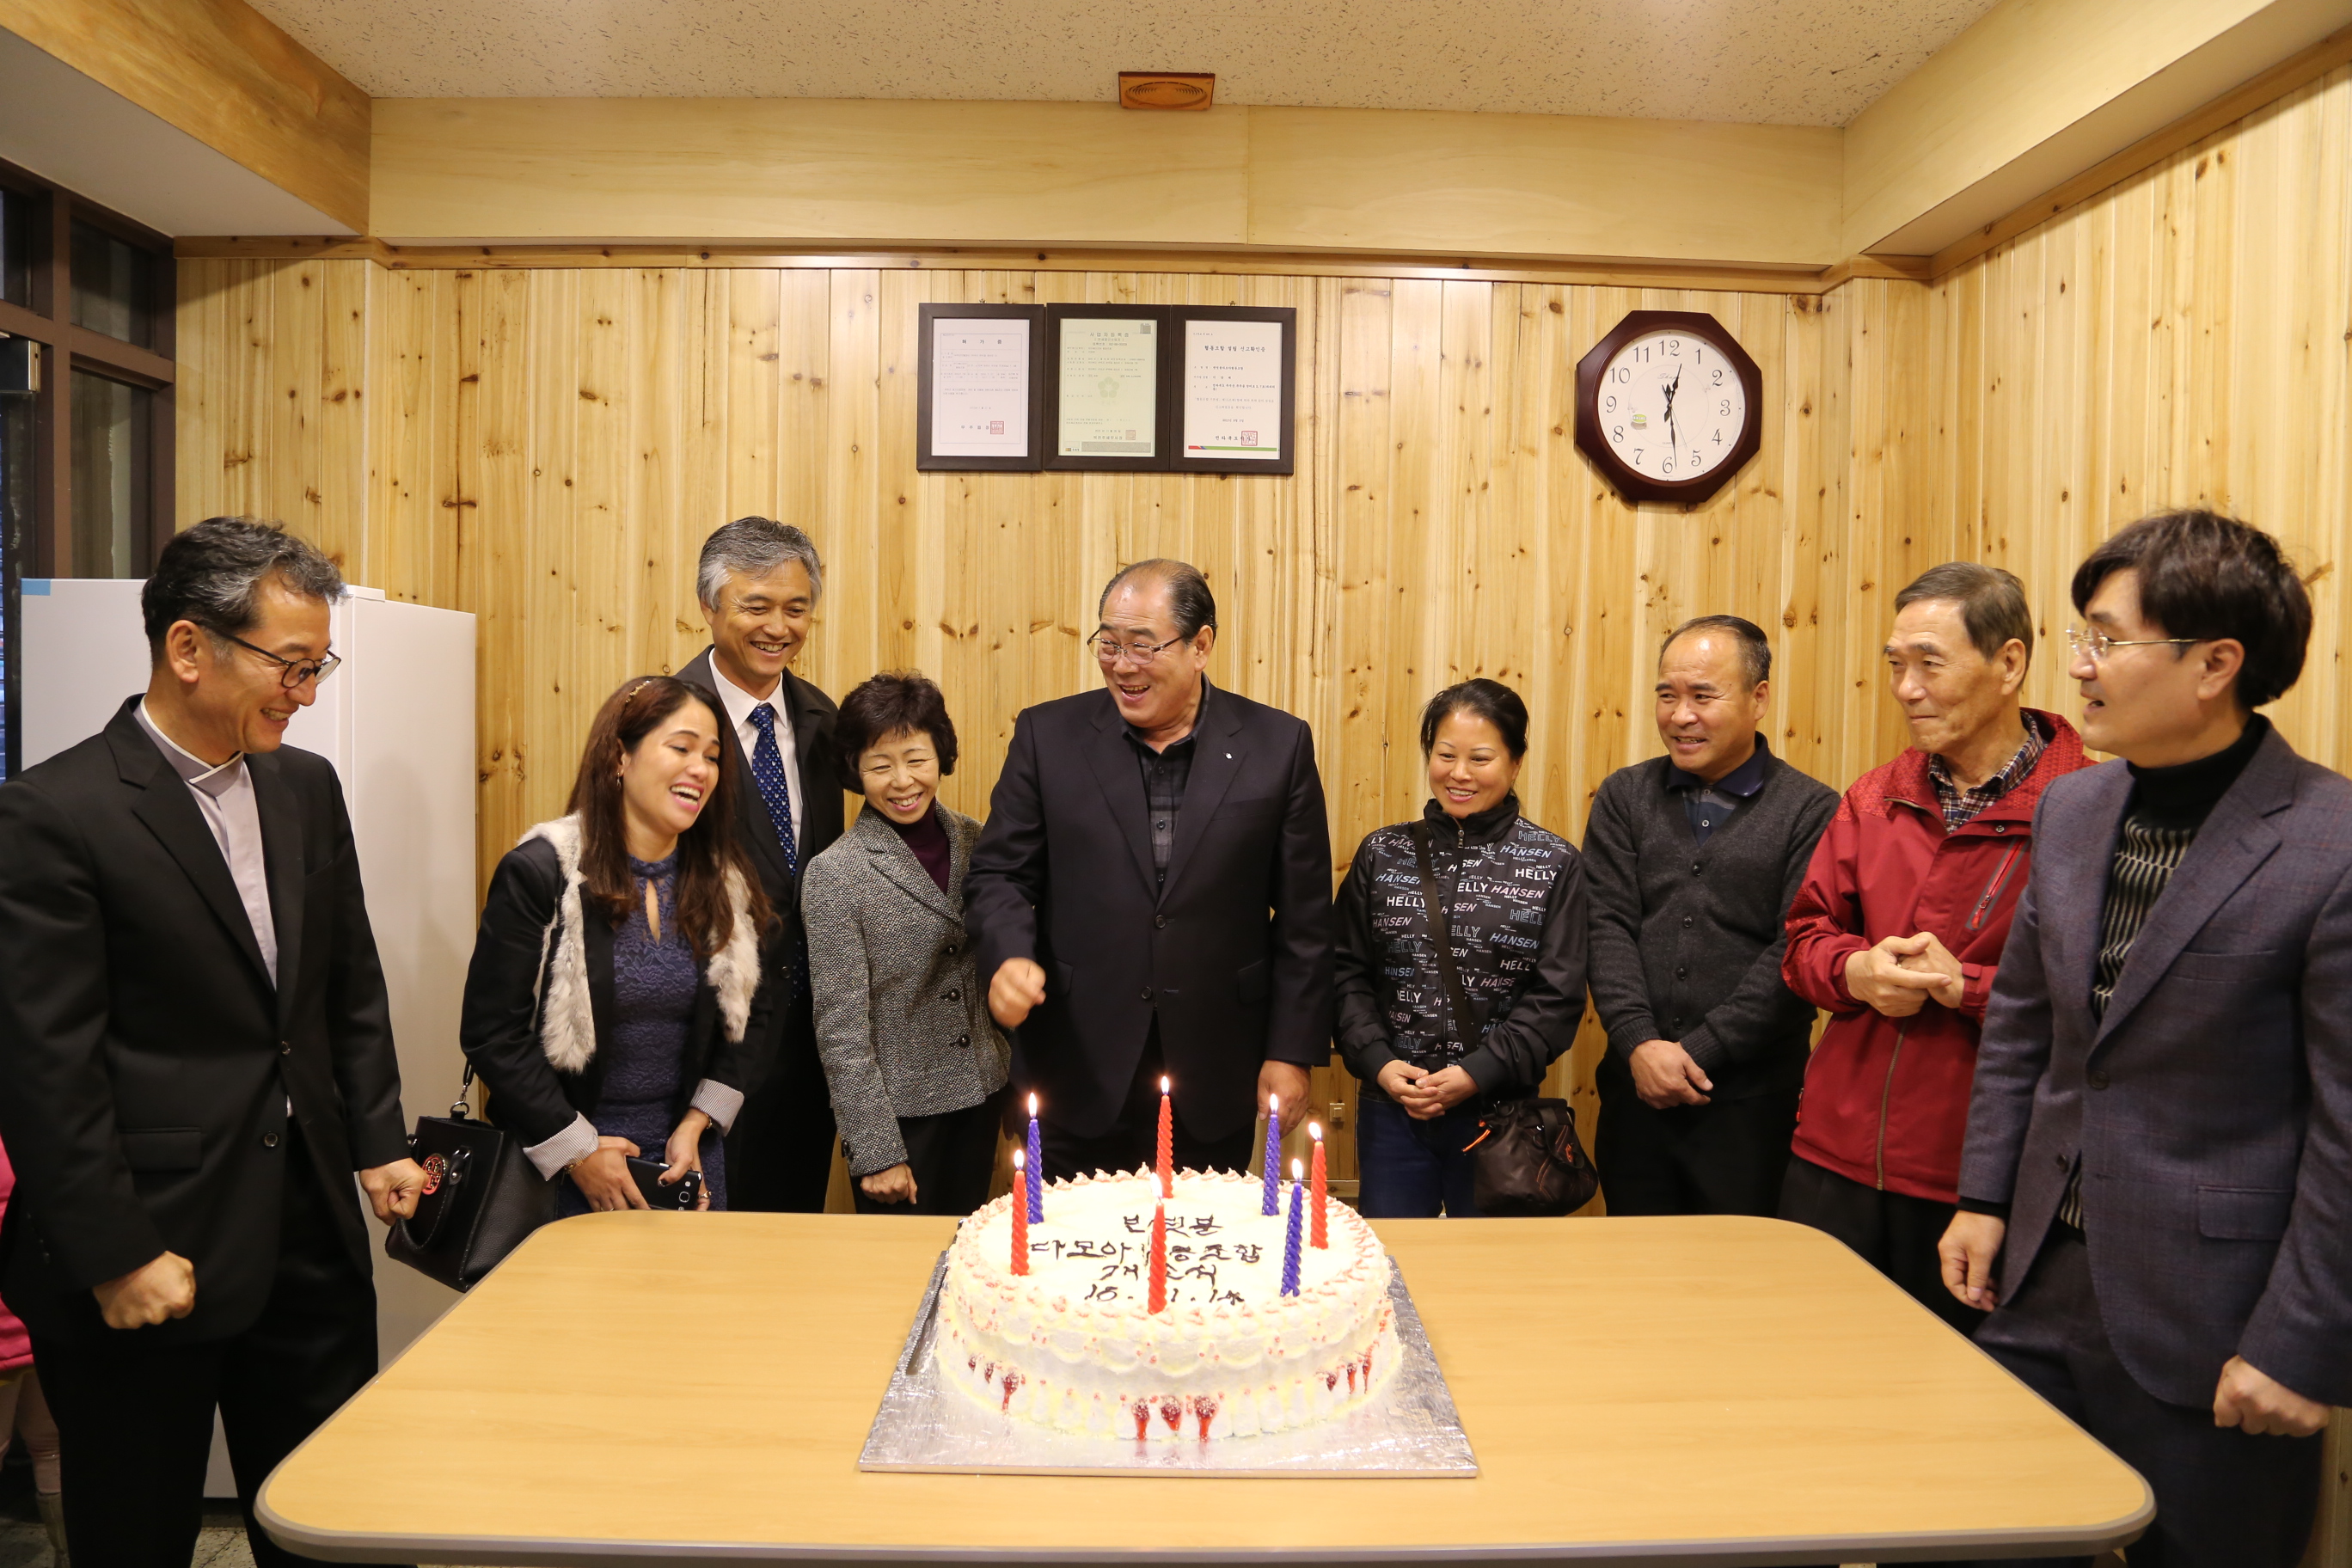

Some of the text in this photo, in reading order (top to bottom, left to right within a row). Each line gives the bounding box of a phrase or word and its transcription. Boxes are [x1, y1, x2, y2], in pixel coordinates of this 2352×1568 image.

[1633, 346, 1650, 364] 11
[1659, 340, 1681, 357] 12
[1695, 348, 1701, 364] 1
[1609, 367, 1631, 384] 10
[1712, 370, 1724, 387] 2
[1606, 395, 1617, 413] 9
[1720, 399, 1730, 416] 3
[1613, 426, 1624, 443] 8
[1712, 428, 1723, 446] 4
[1633, 448, 1645, 465] 7
[1662, 456, 1673, 474] 6
[1691, 450, 1702, 467] 5
[1518, 830, 1561, 842] HELLY
[1500, 845, 1552, 858] HANSEN
[1516, 868, 1557, 881] HELLY
[1457, 882, 1545, 898] ELLY HANSEN
[1373, 917, 1412, 928] HANSEN
[1510, 910, 1543, 925] HELL
[1451, 925, 1480, 938] ELLY
[1490, 933, 1540, 949] HANSEN
[1500, 959, 1530, 971] HELL
